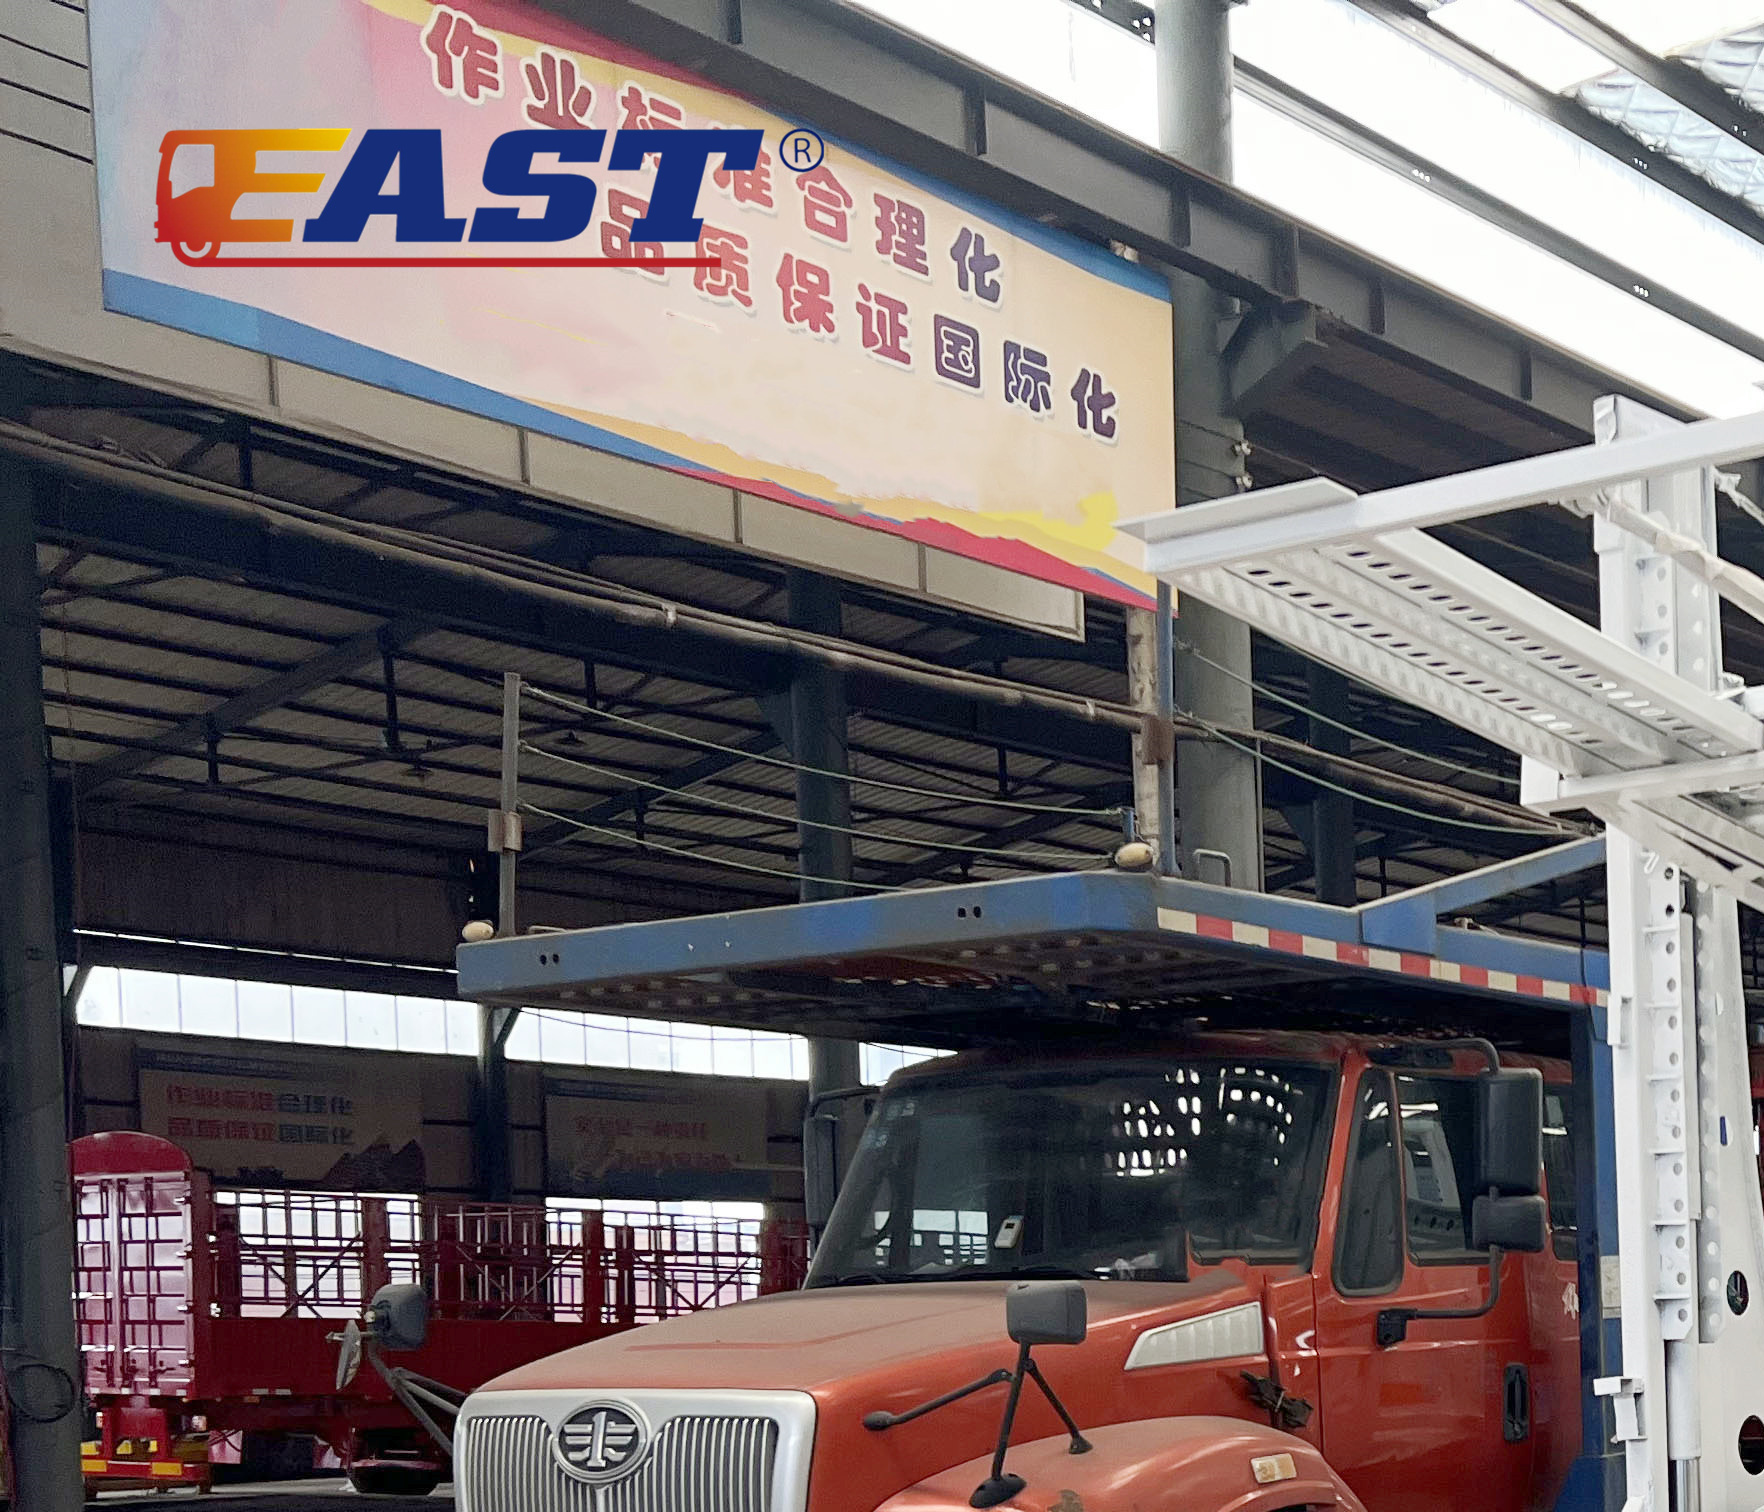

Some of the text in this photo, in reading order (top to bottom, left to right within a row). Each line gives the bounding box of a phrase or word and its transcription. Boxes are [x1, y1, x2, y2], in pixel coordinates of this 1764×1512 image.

[599, 187, 1118, 441] 品质保证国际化
